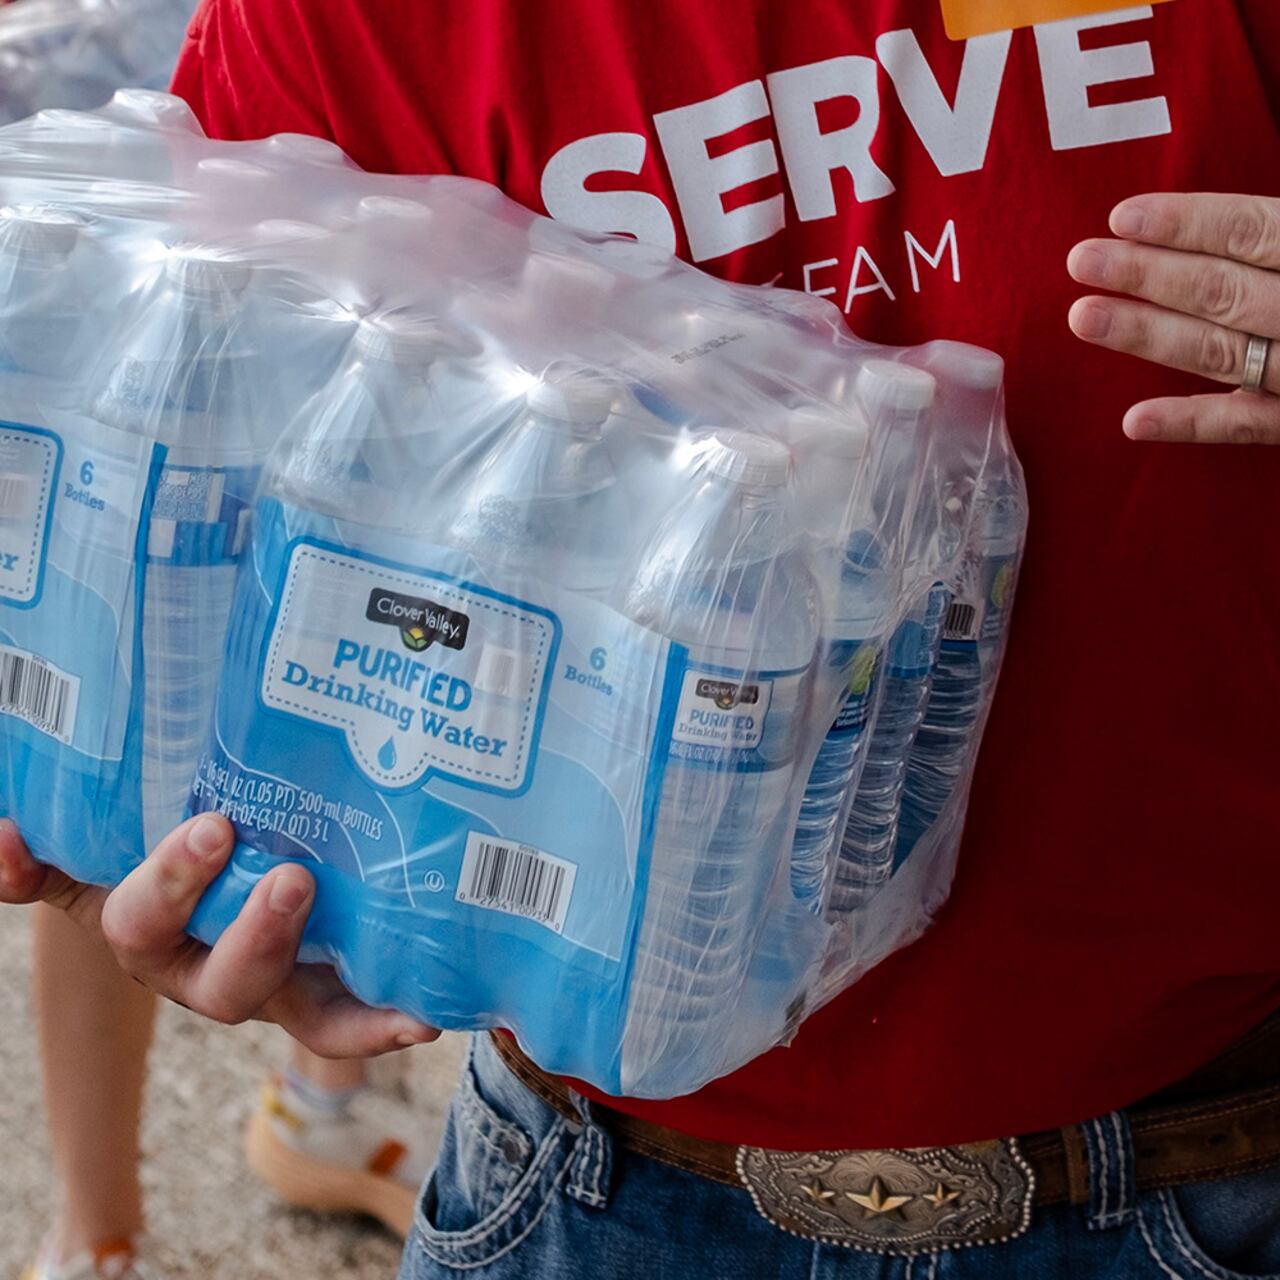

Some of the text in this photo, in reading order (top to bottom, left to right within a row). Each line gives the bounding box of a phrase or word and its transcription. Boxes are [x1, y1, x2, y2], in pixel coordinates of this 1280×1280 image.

[540, 5, 1172, 262] SERVE
[762, 219, 962, 315] EAM
[64, 482, 106, 512] Bottles
[79, 460, 95, 486] 6
[331, 638, 473, 712] PURIFIED
[563, 663, 615, 698] Bottles
[589, 646, 608, 671] 6
[281, 659, 508, 758] Drinking Water
[244, 779, 274, 804] (1.05
[274, 784, 296, 812] PT)
[297, 790, 323, 815] 500
[343, 804, 384, 841] BOTTLES
[287, 813, 311, 841] QT)
